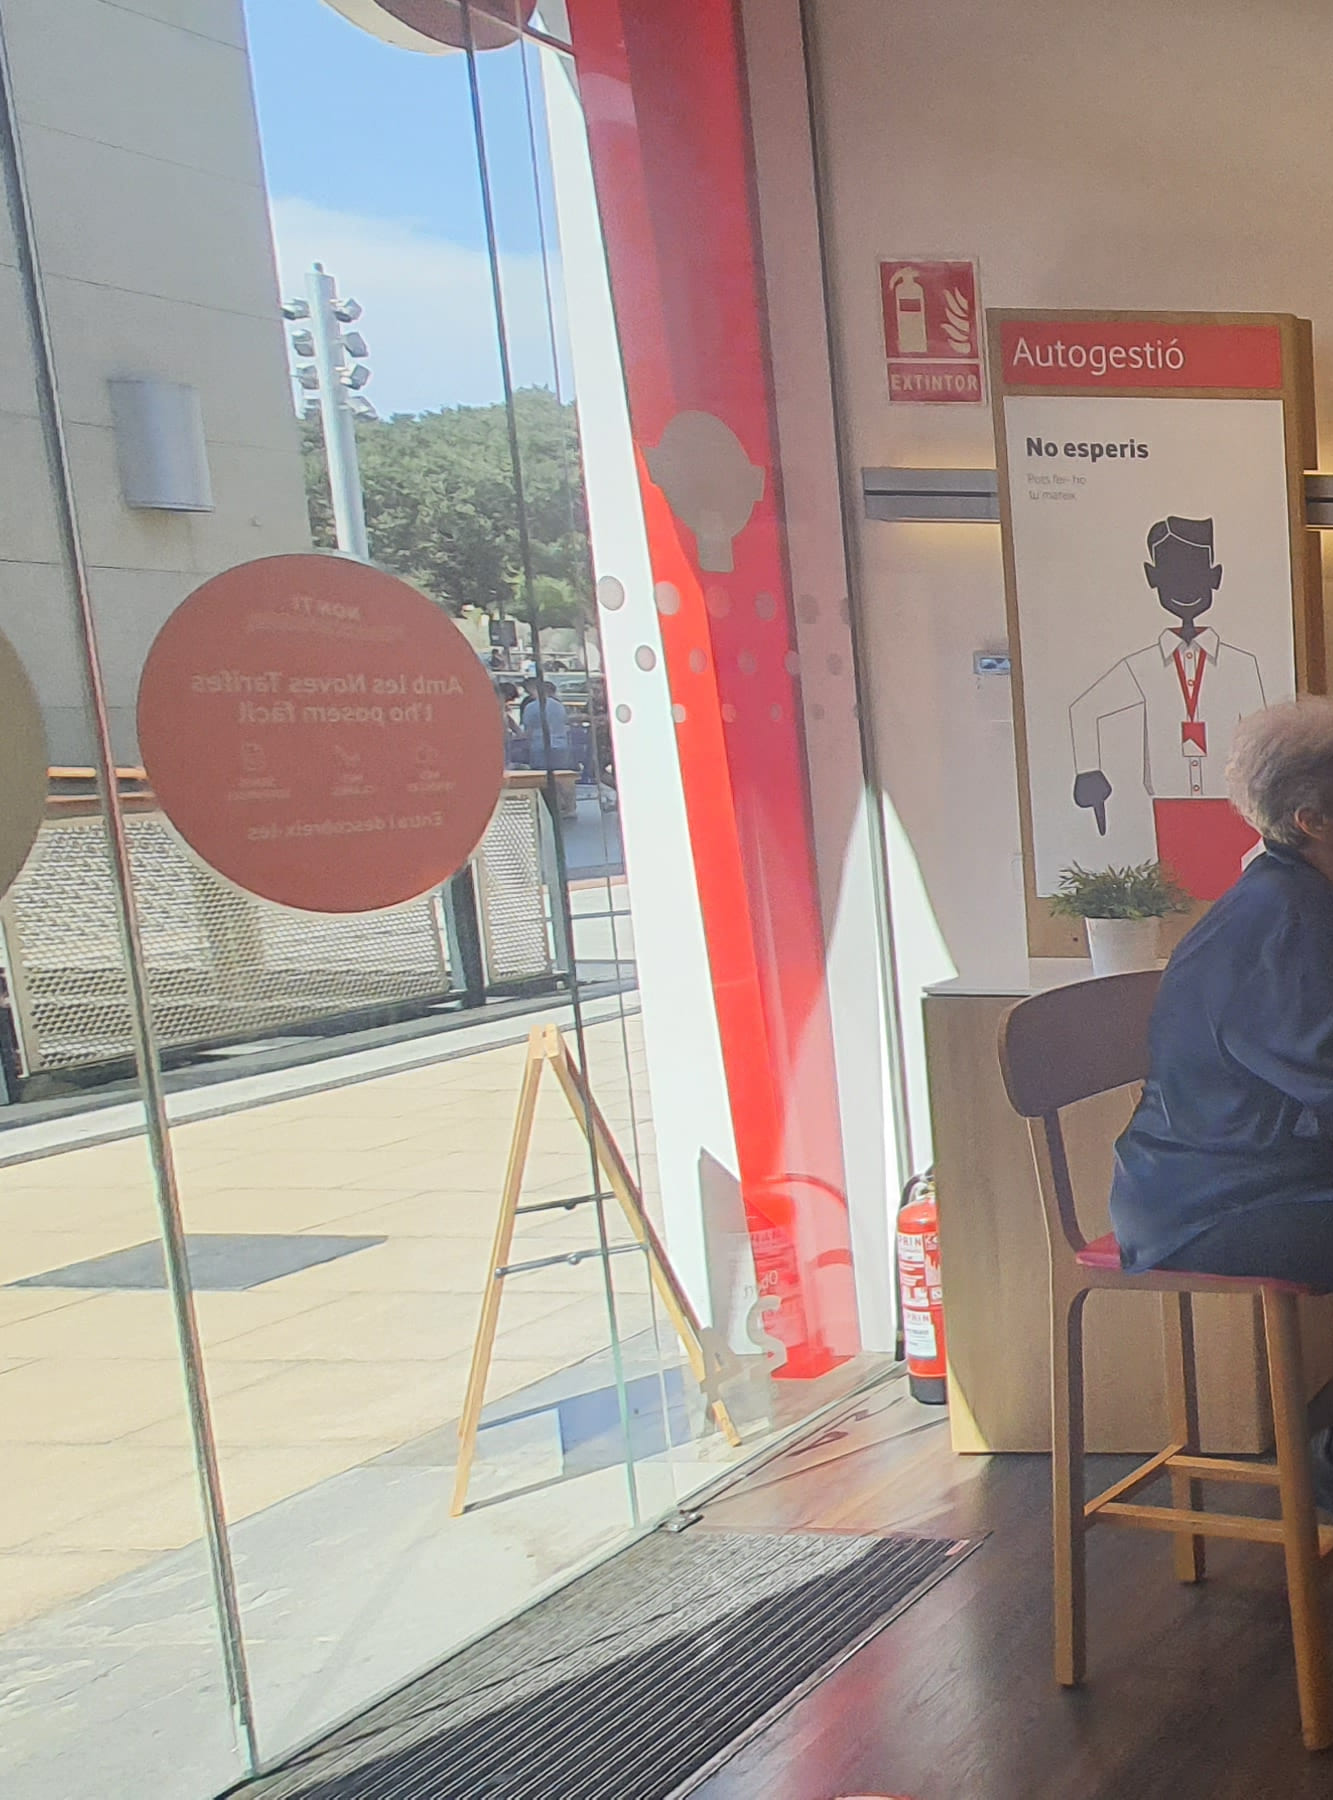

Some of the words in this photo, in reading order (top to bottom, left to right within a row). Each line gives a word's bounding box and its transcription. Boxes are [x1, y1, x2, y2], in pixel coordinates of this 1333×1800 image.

[1012, 337, 1185, 376] Autogestió
[890, 373, 979, 393] EXTINTOR
[1026, 437, 1059, 457] No
[1063, 438, 1149, 463] esperis
